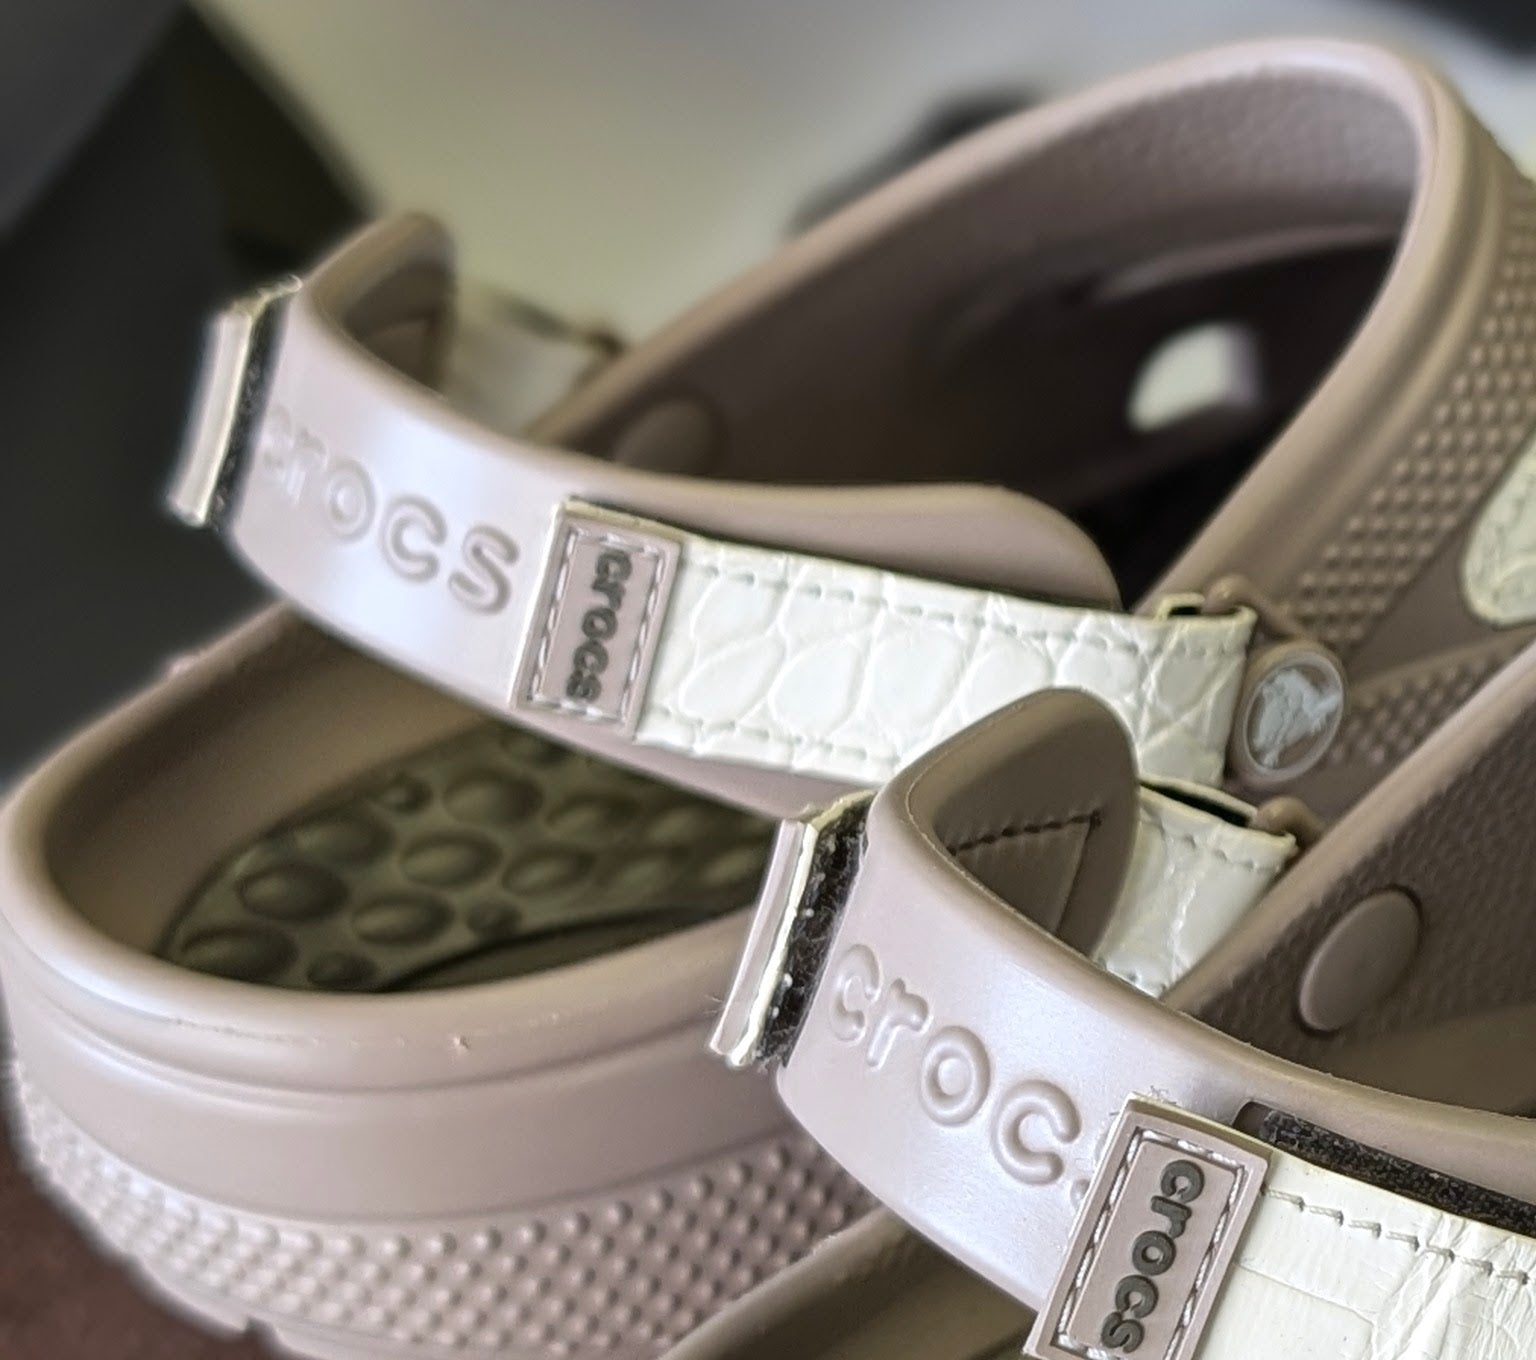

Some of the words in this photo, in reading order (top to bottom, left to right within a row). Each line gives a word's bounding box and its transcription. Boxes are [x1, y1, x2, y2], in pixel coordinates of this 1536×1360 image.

[566, 549, 633, 704] crocs
[831, 943, 1098, 1211] croc
[1101, 1160, 1206, 1354] crocs
